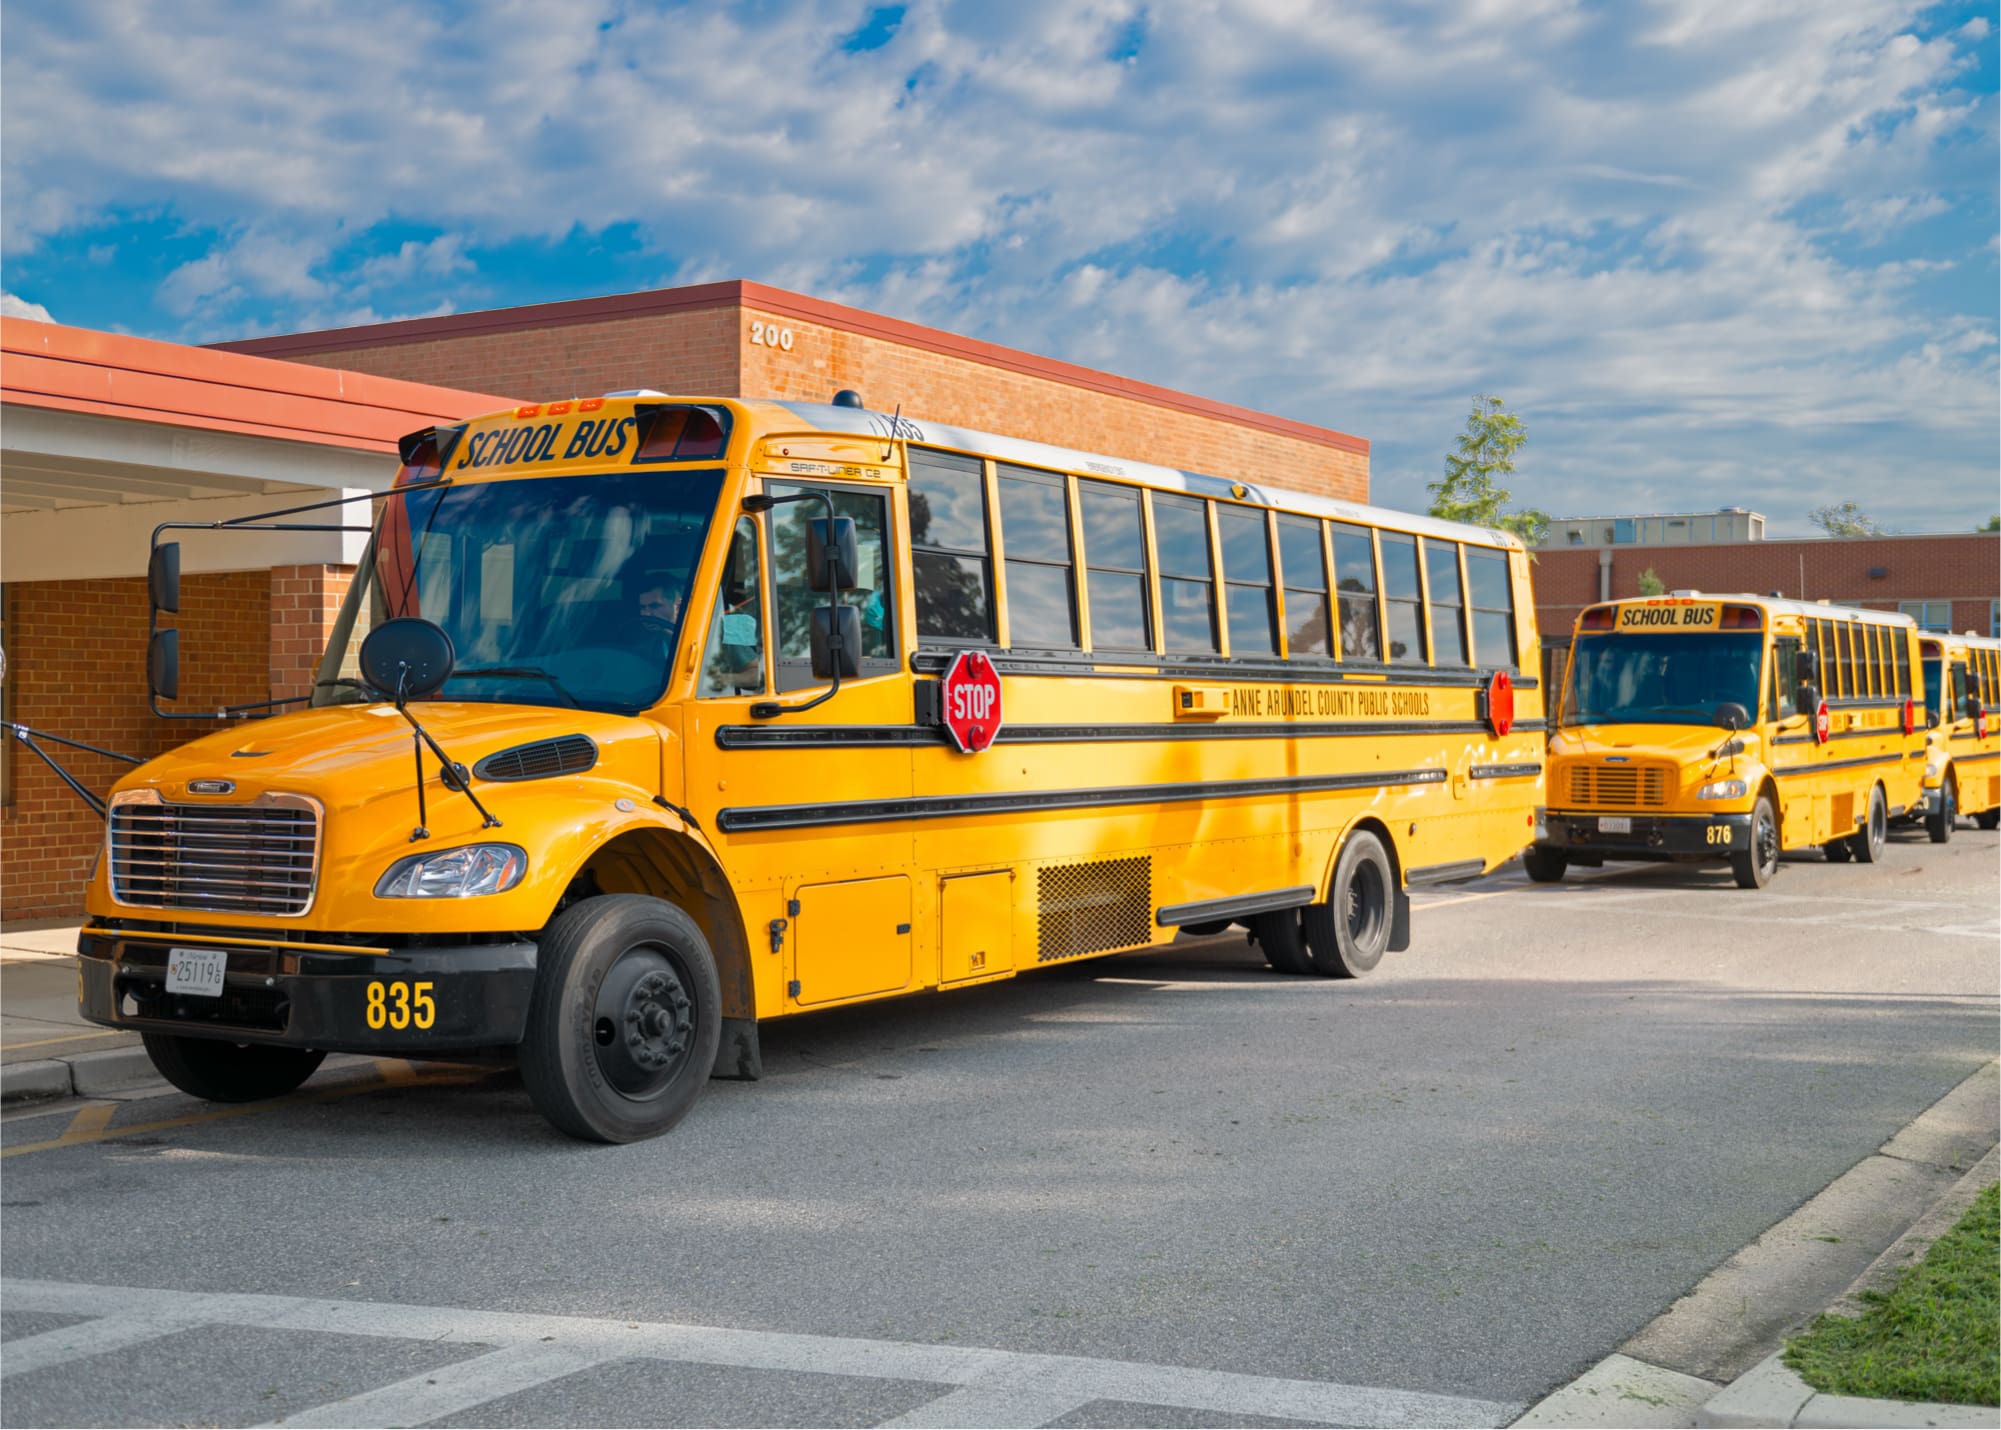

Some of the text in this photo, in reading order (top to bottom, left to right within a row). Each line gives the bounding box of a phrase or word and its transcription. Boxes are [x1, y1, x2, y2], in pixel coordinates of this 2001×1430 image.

[751, 321, 793, 350] 200
[457, 416, 636, 469] SCHOOL BUS
[866, 469, 881, 479] C2
[1621, 607, 1715, 626] SCHOOL BUS
[954, 683, 995, 720] STOP
[1232, 689, 1429, 717] ANNE ARUNDEL COUNTY PUBLIC SCHOOLS
[1706, 825, 1732, 844] 876
[367, 981, 435, 1029] 835
